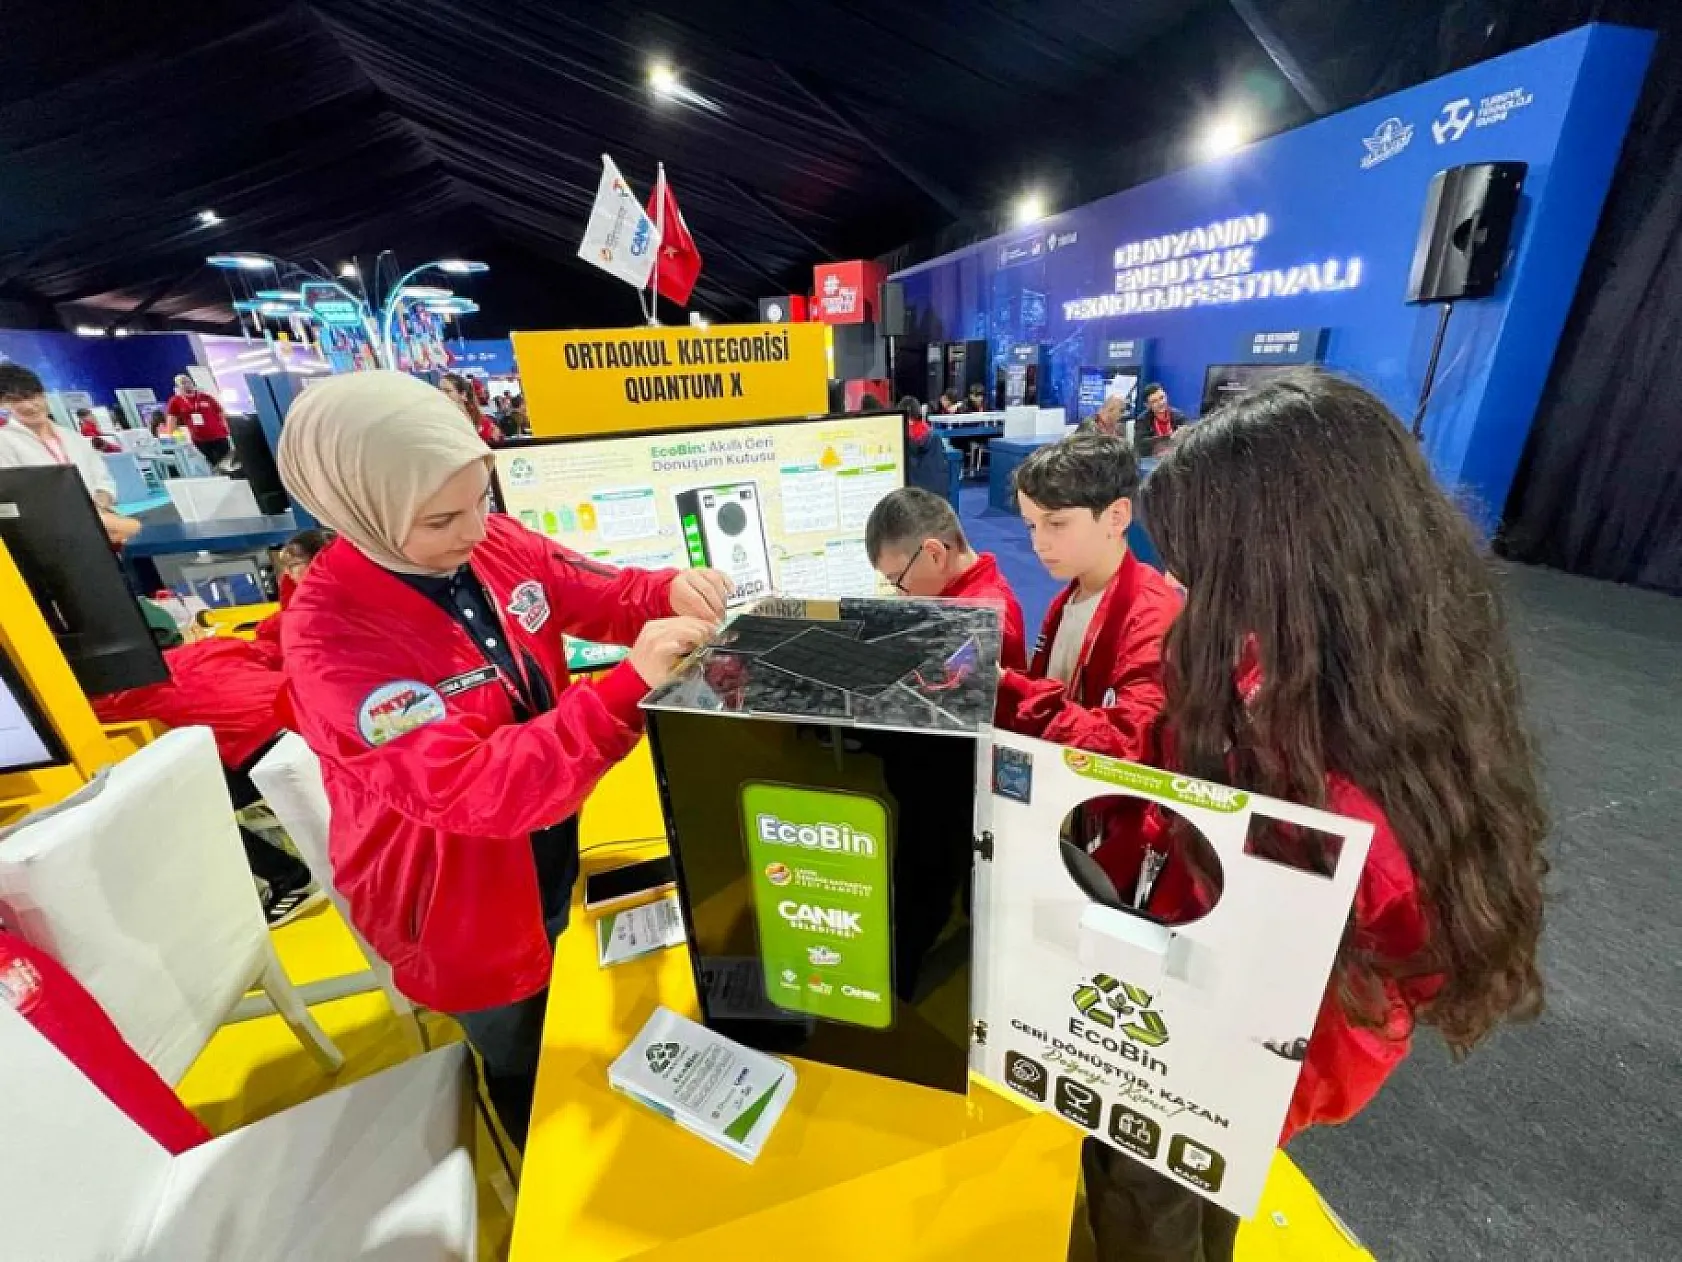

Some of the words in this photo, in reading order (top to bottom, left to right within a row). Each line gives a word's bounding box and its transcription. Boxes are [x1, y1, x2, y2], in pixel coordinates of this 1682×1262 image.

[564, 340, 673, 370] ORTAOKUL
[677, 330, 790, 365] KATEGORİSİ
[625, 372, 724, 404] QUANTUM
[730, 371, 743, 398] X
[726, 452, 776, 465] Kutusu
[757, 814, 877, 858] EcoBin
[1068, 1016, 1168, 1077] EcoBin
[1010, 1018, 1048, 1043] GERİ
[1160, 1087, 1230, 1129] KAZAN
